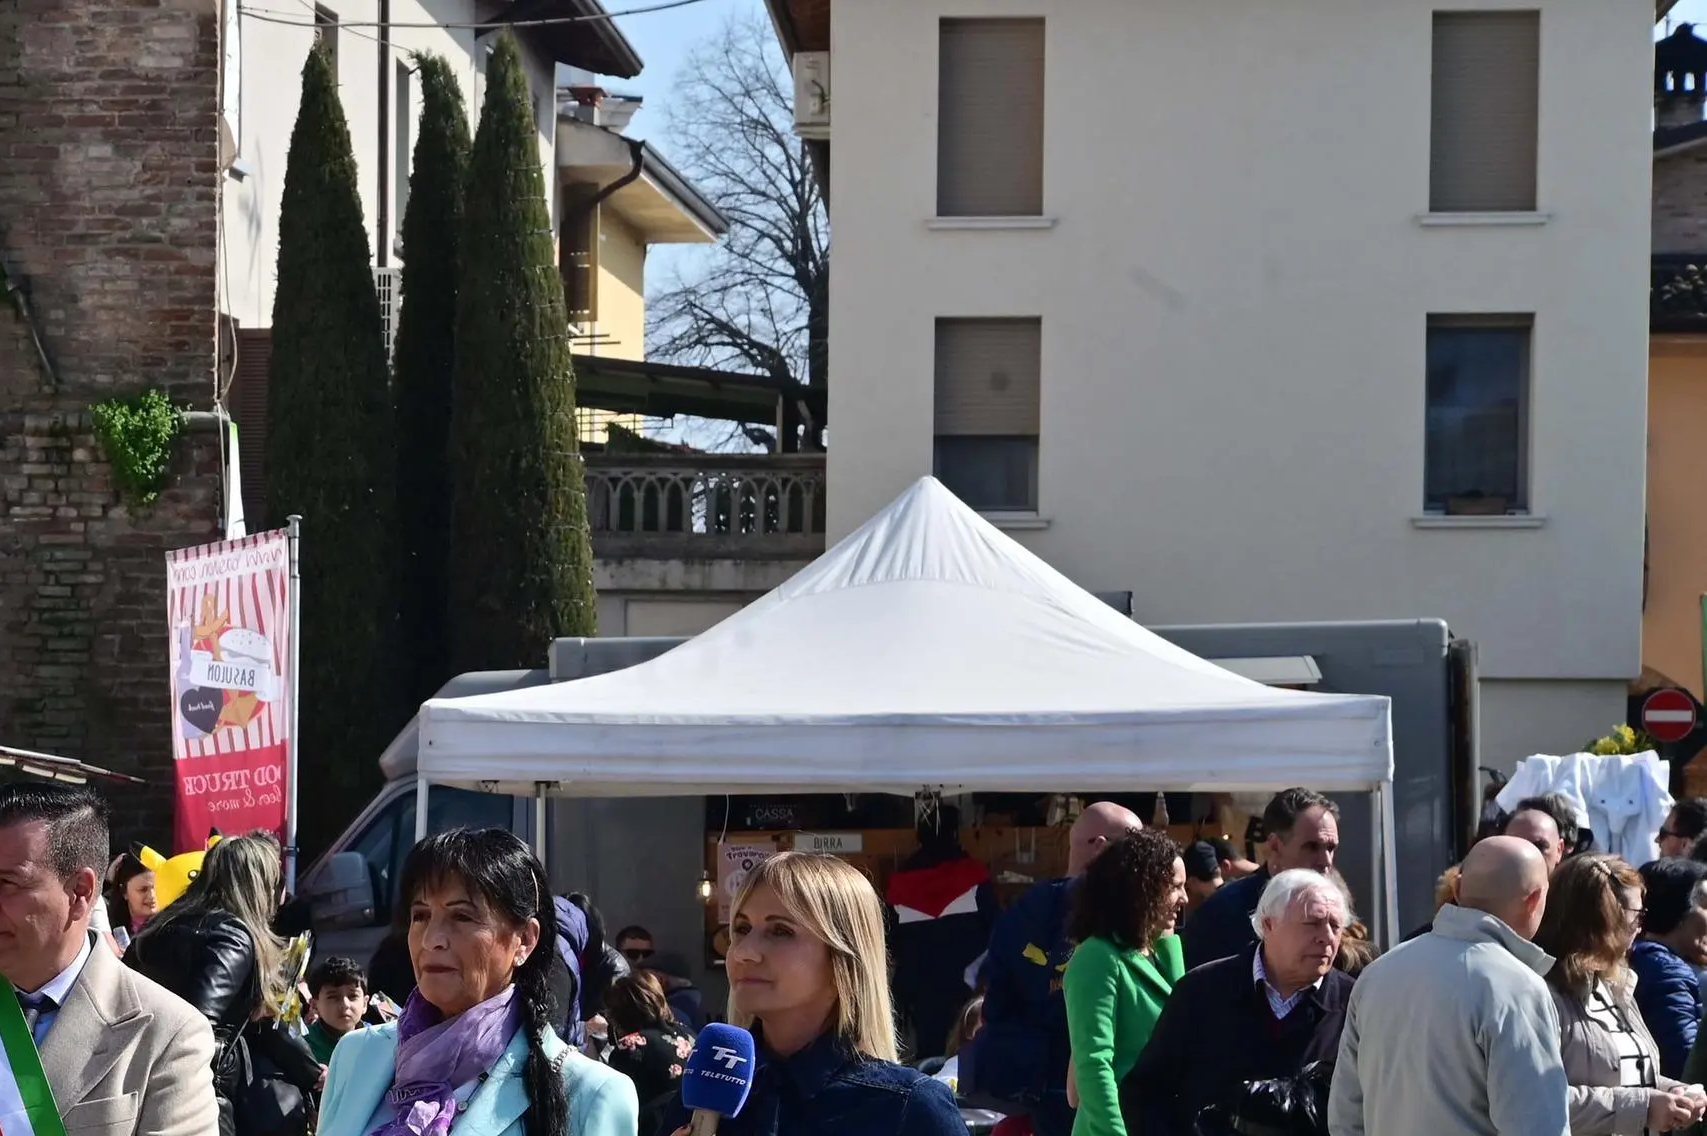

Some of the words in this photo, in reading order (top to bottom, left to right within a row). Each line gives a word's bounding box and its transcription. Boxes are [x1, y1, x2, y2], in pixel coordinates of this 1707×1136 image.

[755, 808, 794, 820] CASSA
[814, 837, 844, 850] BIRRA
[700, 1070, 746, 1085] TELETUTTO
